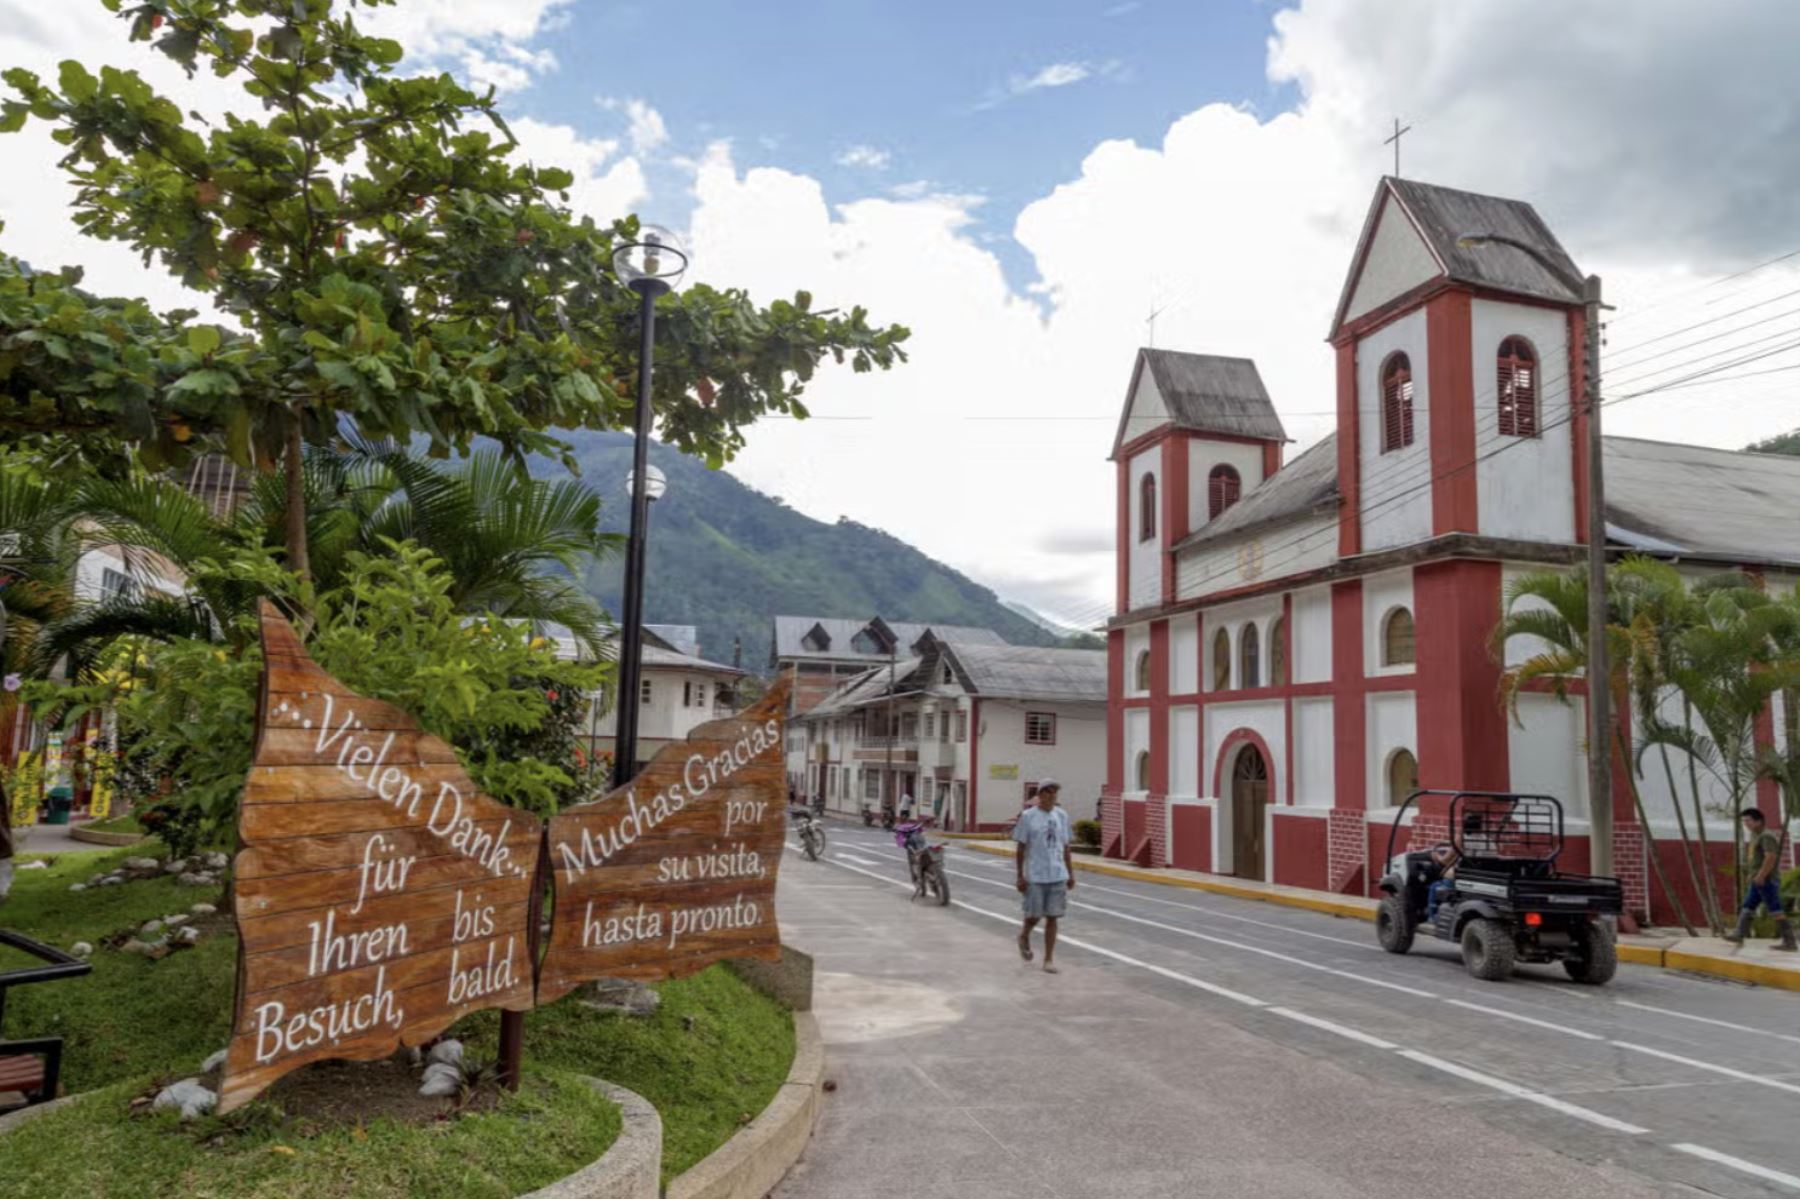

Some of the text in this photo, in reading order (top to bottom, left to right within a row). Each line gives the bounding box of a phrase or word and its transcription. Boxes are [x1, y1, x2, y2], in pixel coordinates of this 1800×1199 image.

[556, 718, 780, 885] Muchas Gracias
[725, 800, 769, 837] por
[350, 834, 416, 915] für
[657, 843, 766, 883] su visita,
[307, 909, 410, 976] Ihren
[452, 889, 495, 943] bis
[583, 893, 762, 949] hasta pronto.
[447, 936, 519, 1005] bald.
[254, 966, 403, 1062] Besuch,
